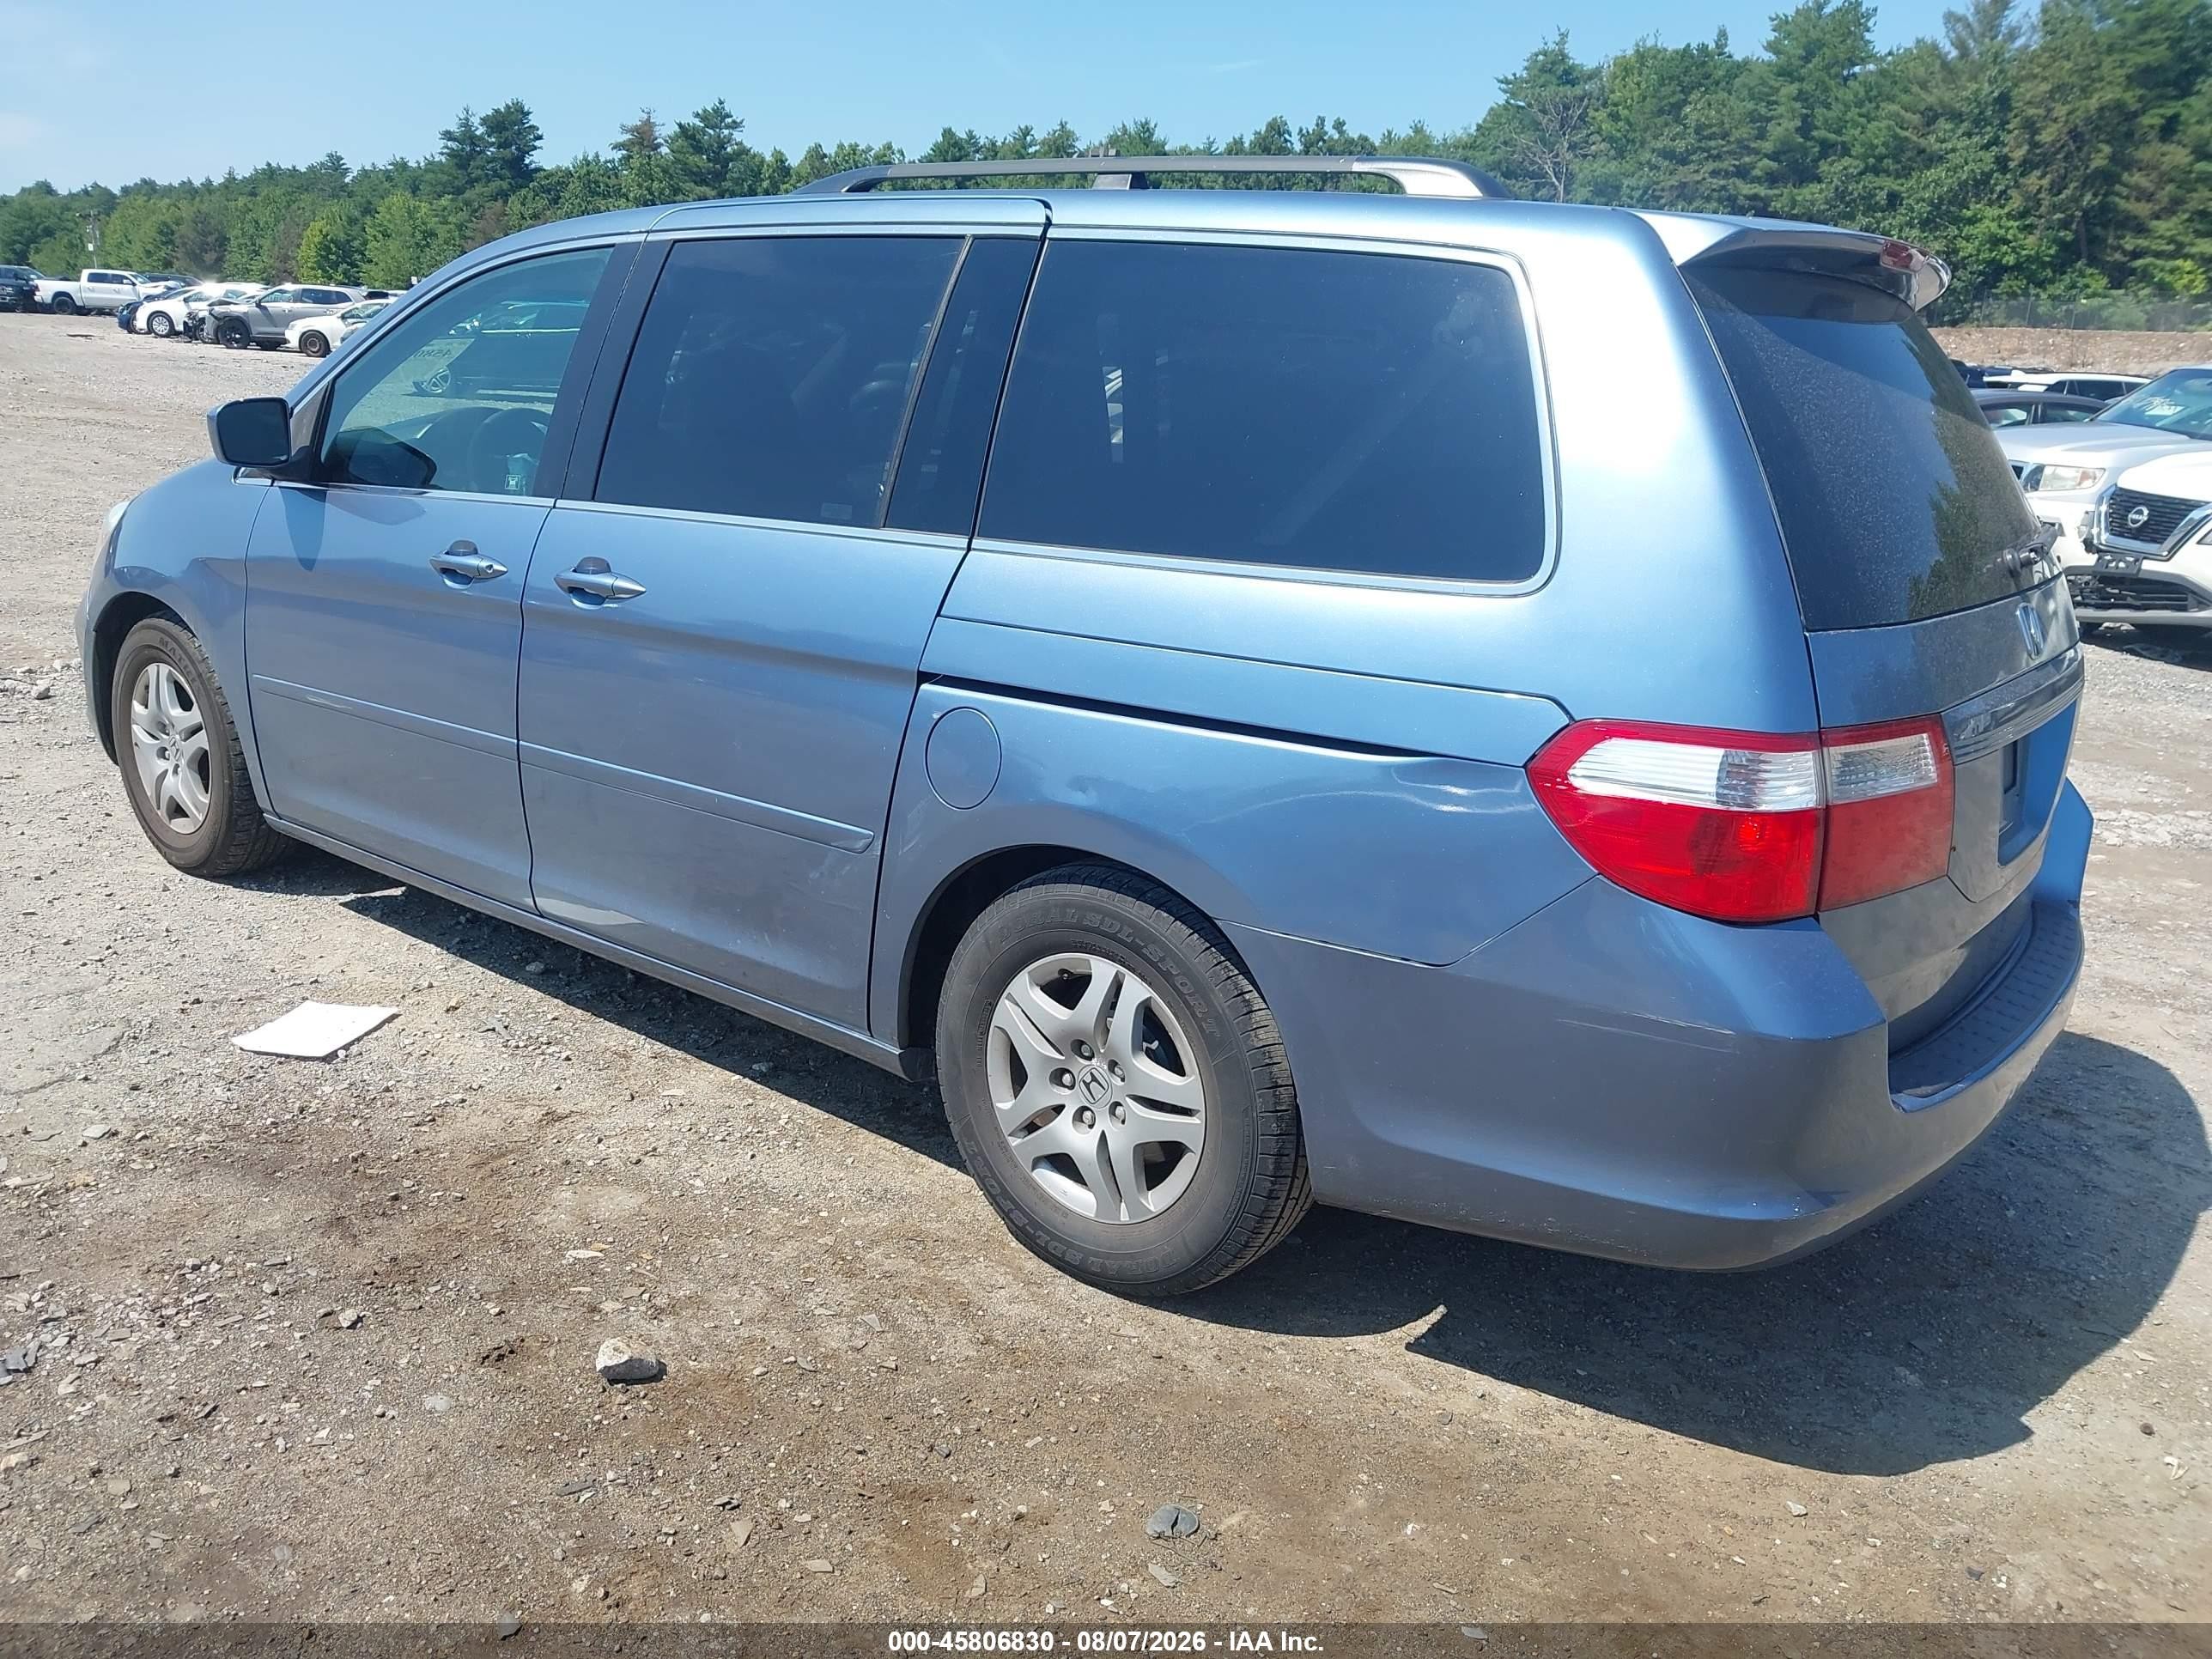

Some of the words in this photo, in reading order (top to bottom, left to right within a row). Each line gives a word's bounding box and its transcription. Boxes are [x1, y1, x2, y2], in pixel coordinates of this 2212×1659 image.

[999, 906, 1079, 943] DORAL
[1083, 913, 1220, 1037] SDL-SPORT
[963, 1139, 1084, 1266] SDL-SPORT
